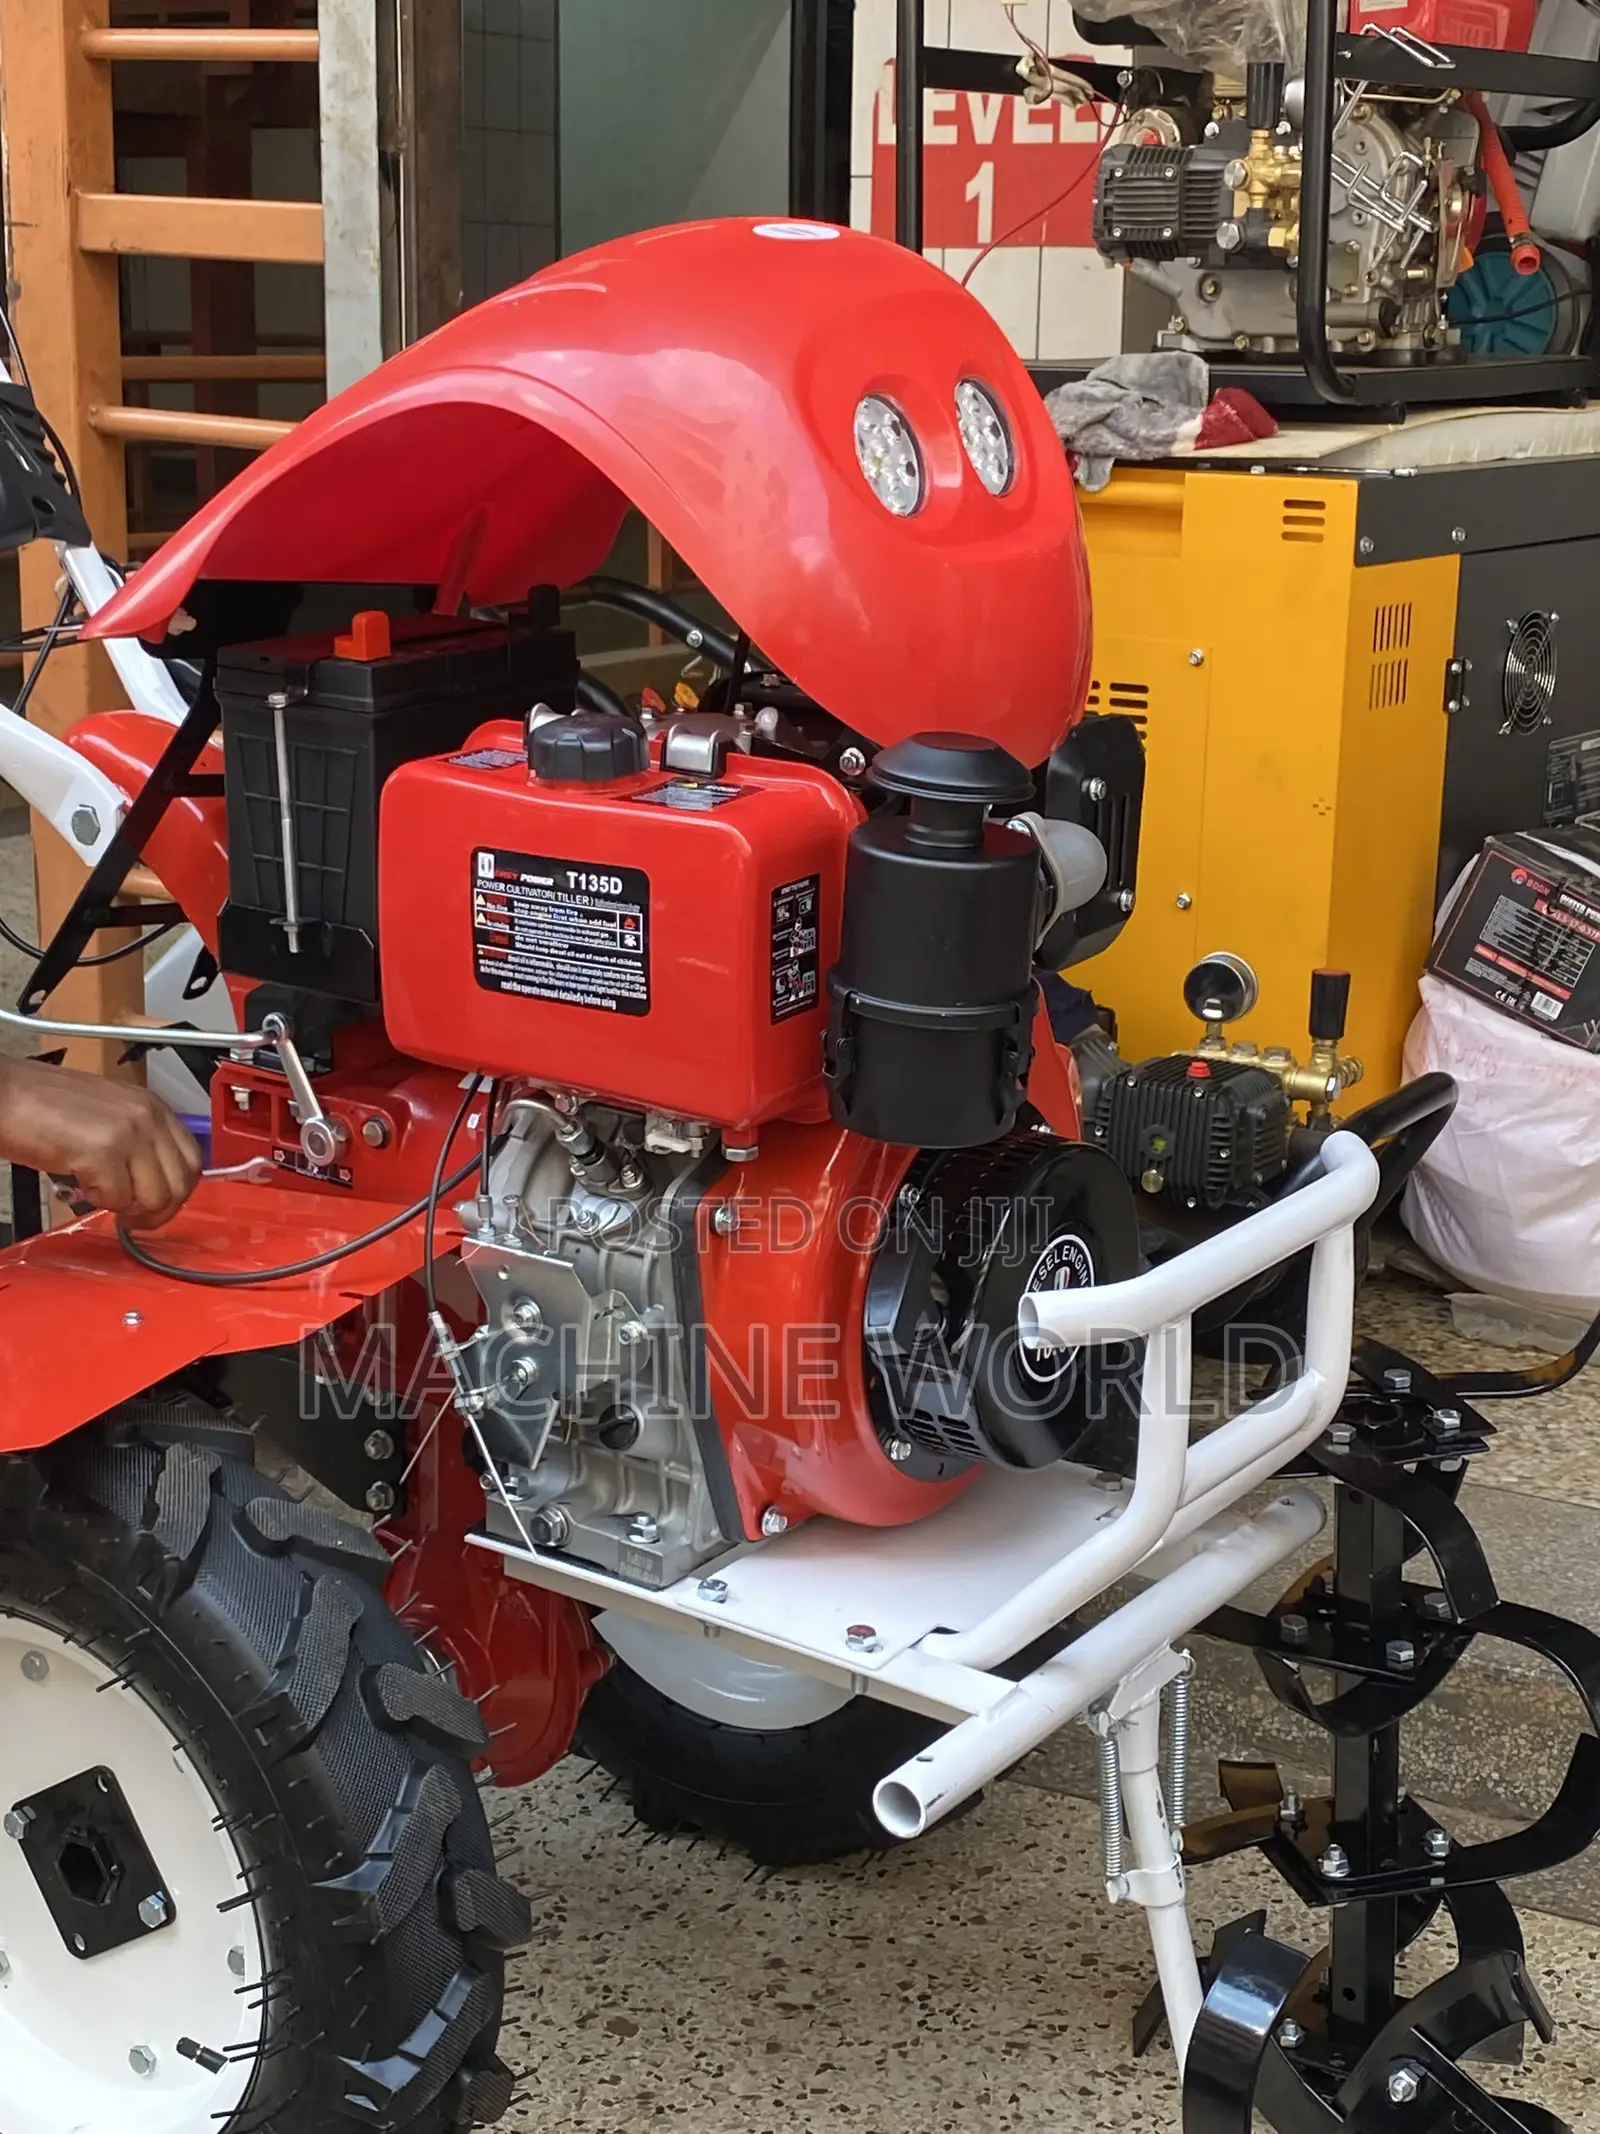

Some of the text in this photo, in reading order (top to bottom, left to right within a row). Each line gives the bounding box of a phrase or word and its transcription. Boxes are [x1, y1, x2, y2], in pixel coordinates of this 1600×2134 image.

[965, 161, 995, 244] 1
[477, 880, 506, 892] POWER
[566, 871, 623, 895] T135D
[1560, 893, 1587, 915] WATER
